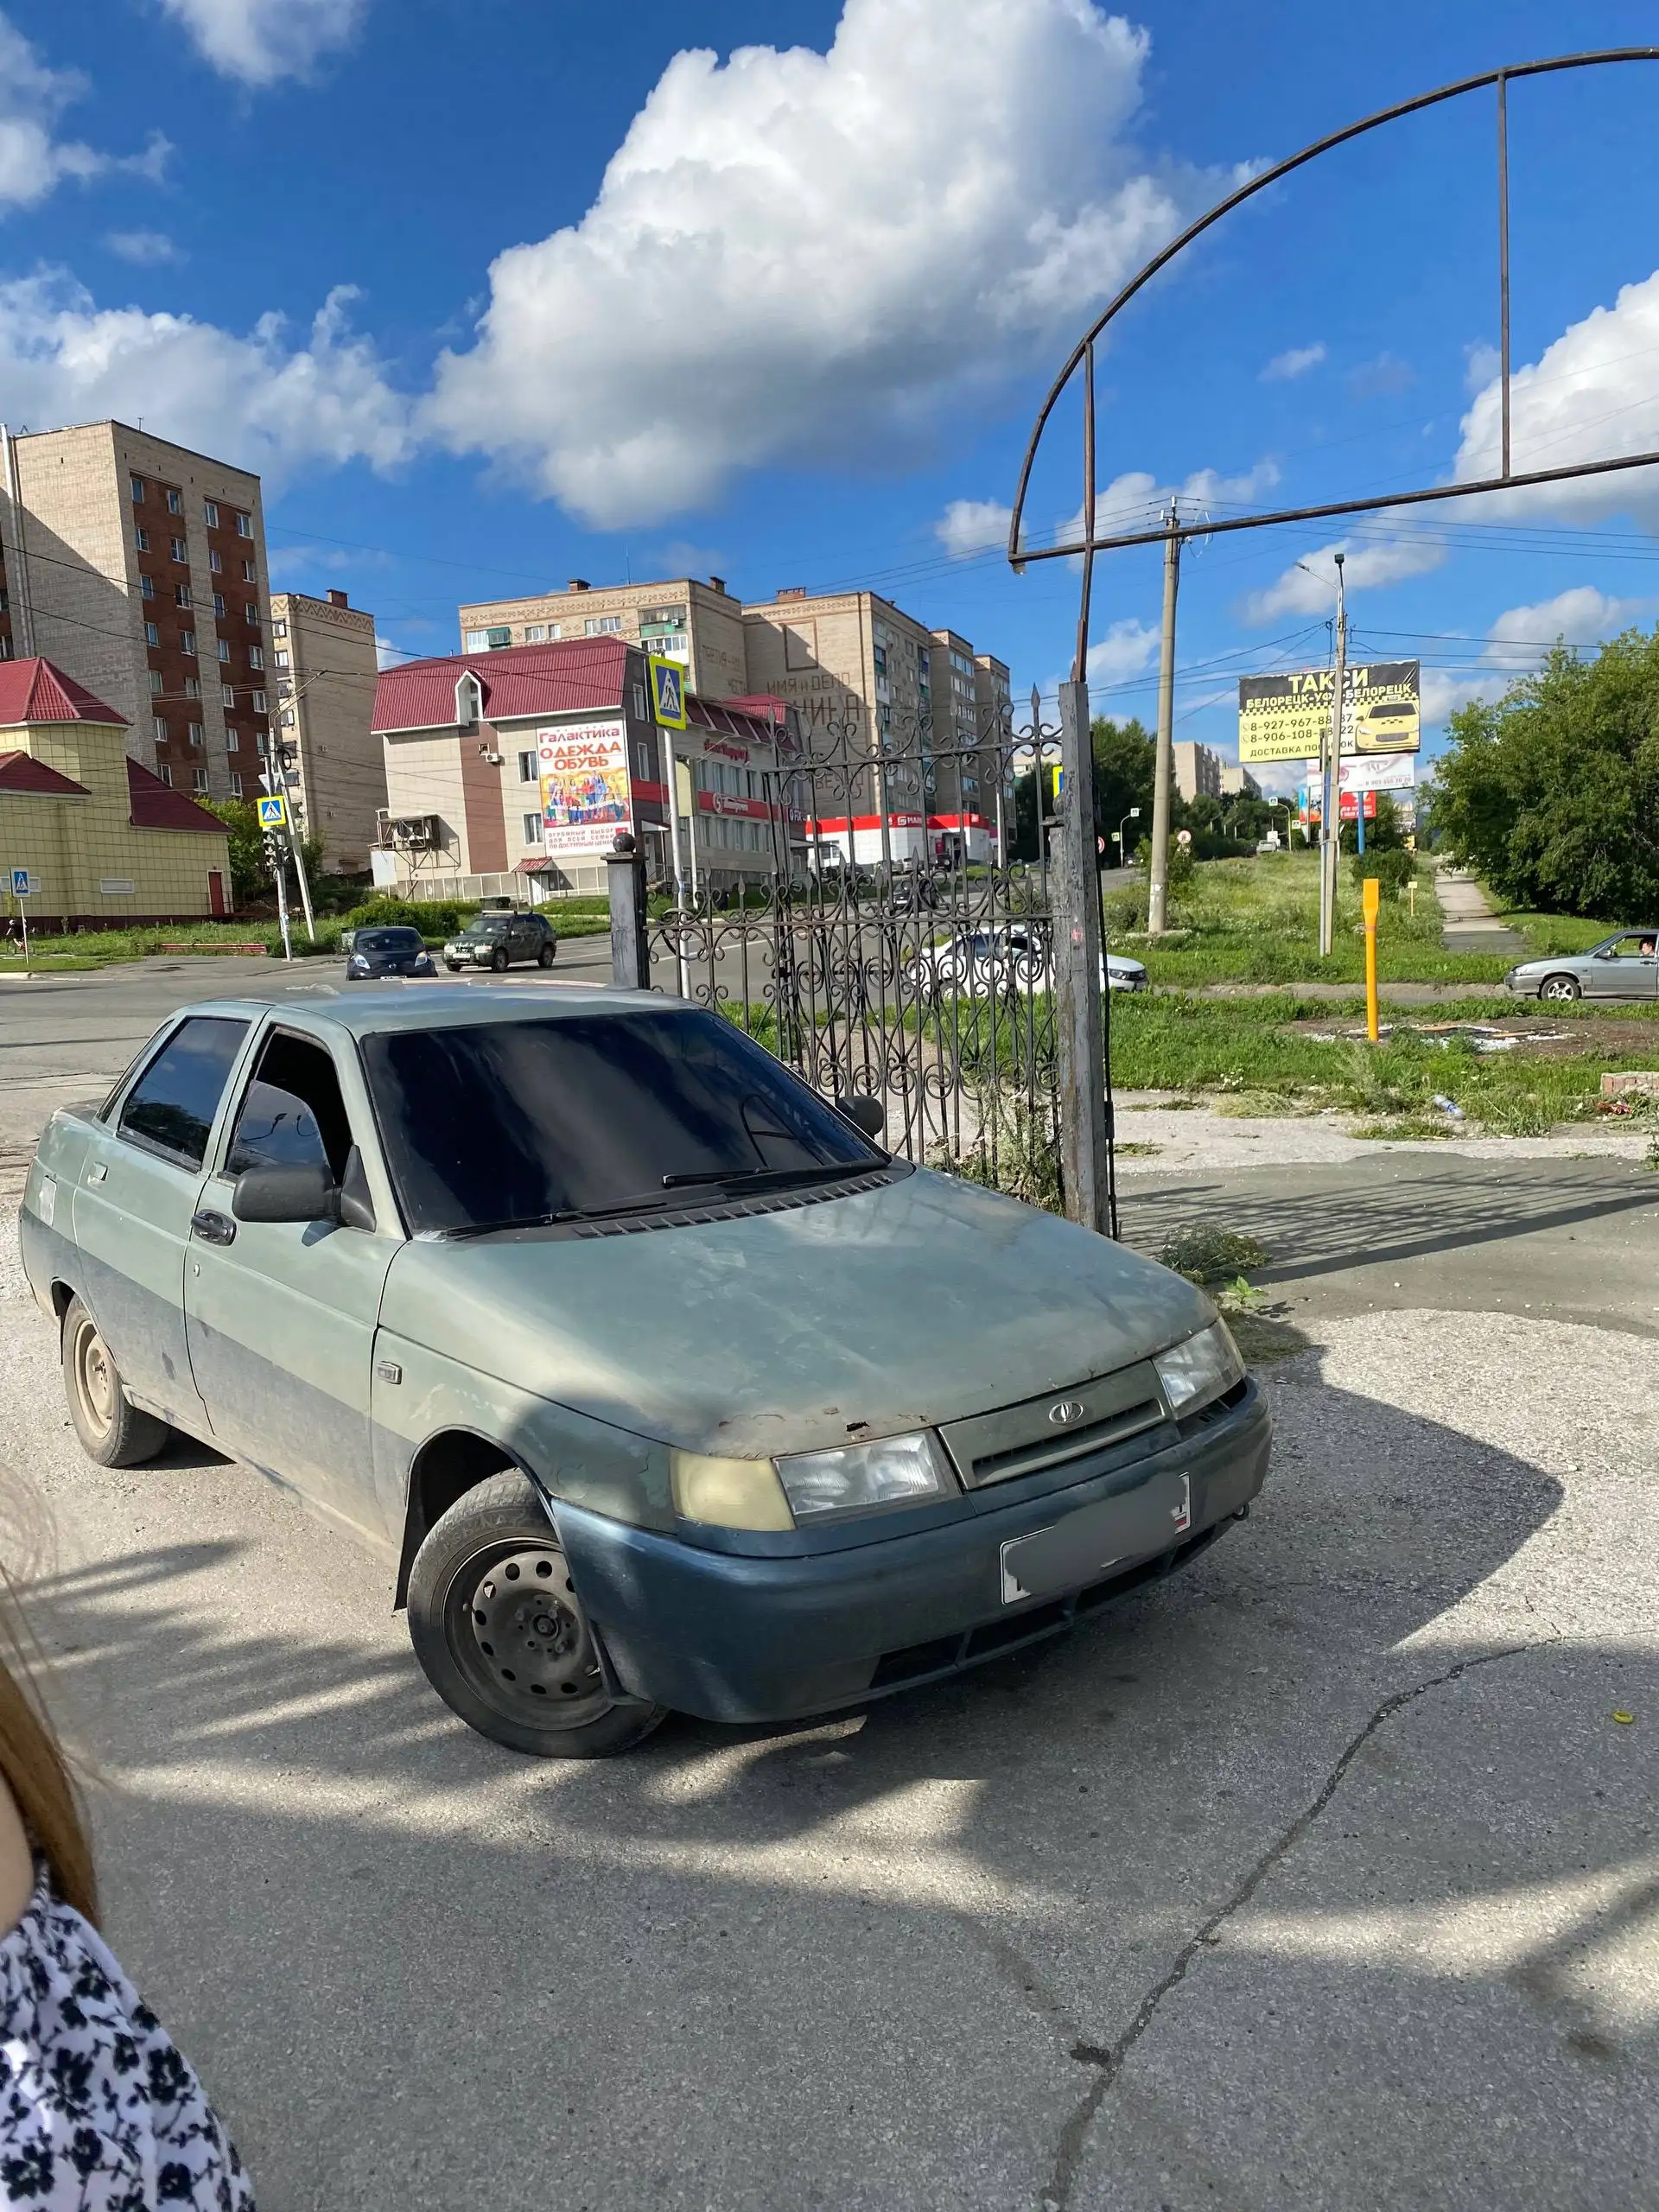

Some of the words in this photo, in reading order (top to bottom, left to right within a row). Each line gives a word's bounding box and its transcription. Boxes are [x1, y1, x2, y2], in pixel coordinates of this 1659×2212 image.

[539, 728, 620, 743] Галактика
[540, 741, 621, 759] ОДЕЖДА
[1250, 746, 1301, 758] ДОСТАВКА
[555, 756, 609, 770] ОБУВЬ
[549, 830, 586, 838] ОГРОМНЫЙ
